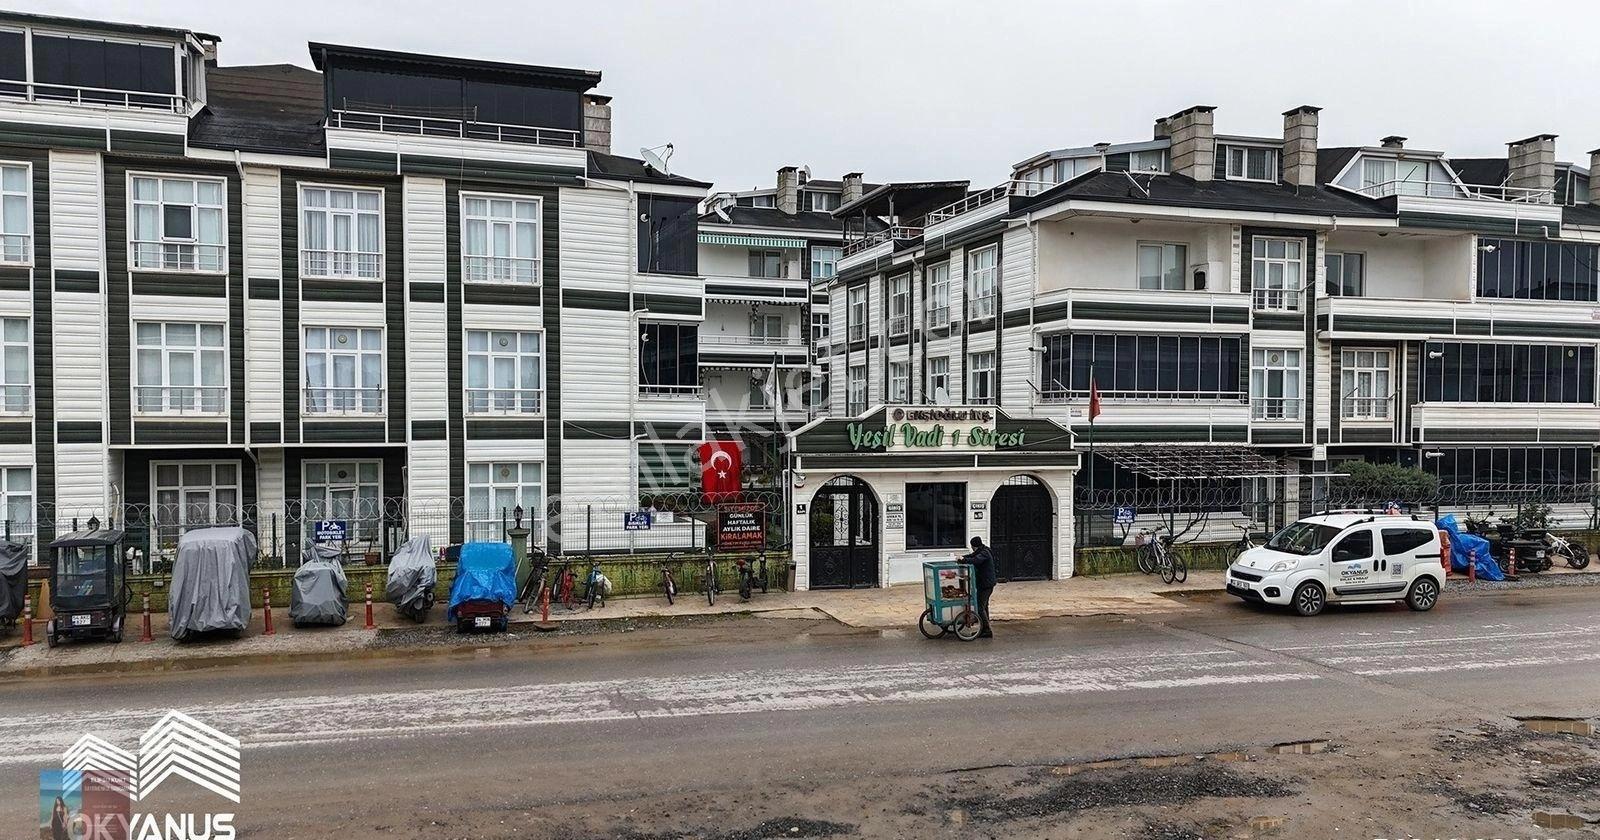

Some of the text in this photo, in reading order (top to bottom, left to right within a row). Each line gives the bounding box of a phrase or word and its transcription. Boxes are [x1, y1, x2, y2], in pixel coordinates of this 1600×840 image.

[847, 423, 1026, 450] Yeşil Vadi 1 Sitesi
[720, 532, 763, 540] KİRALAMAK
